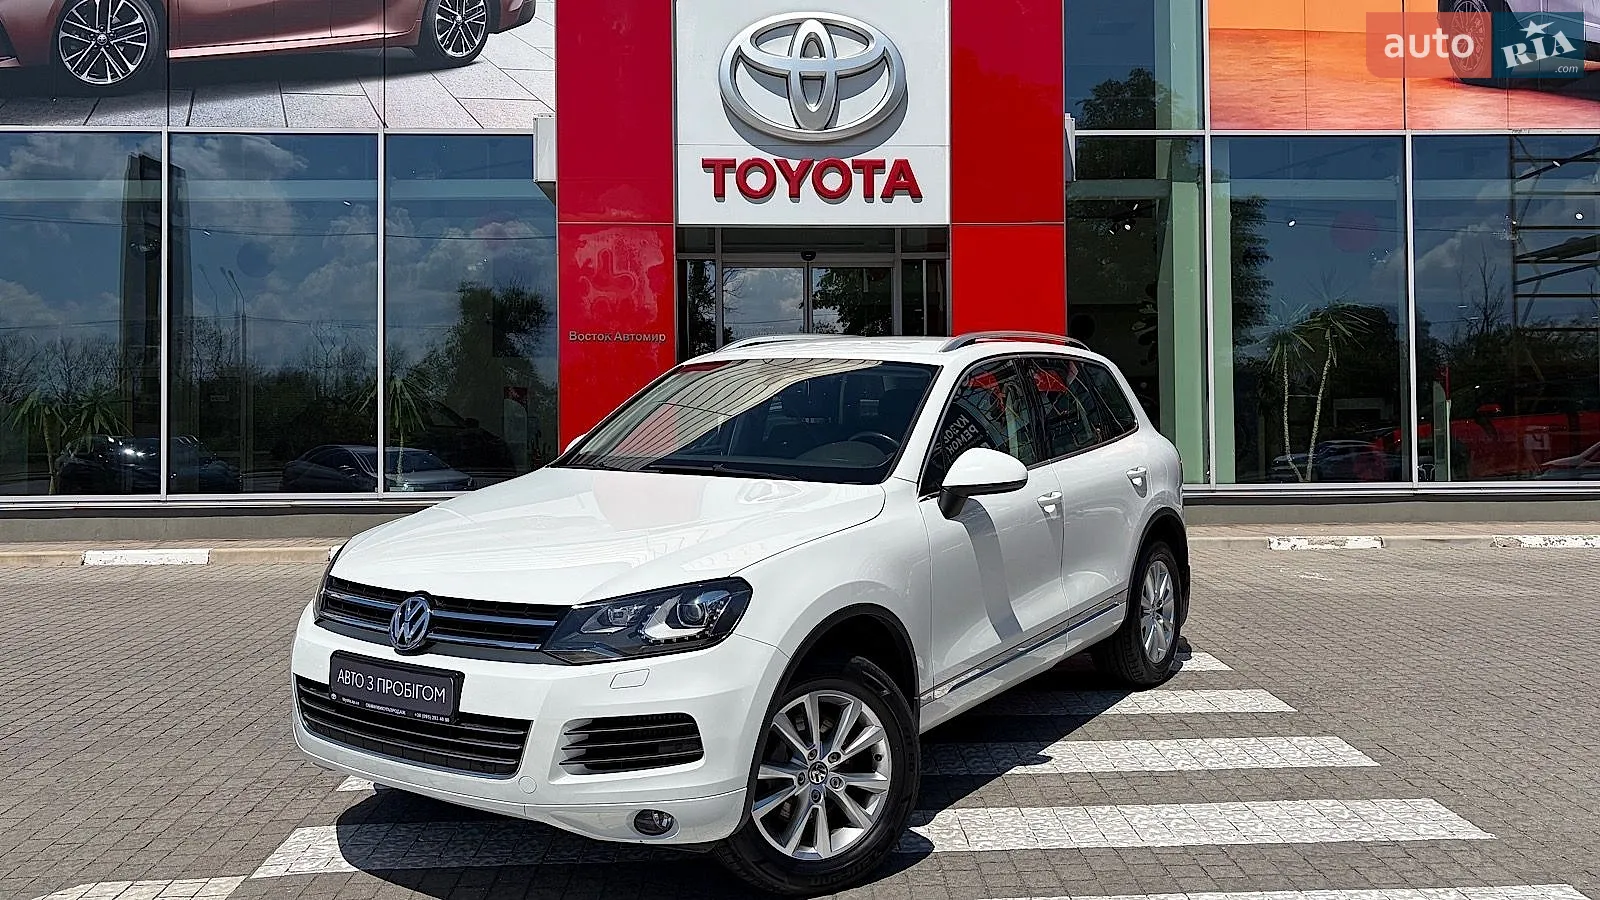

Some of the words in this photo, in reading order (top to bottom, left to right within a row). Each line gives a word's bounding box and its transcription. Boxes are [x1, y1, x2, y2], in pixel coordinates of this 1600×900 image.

[701, 157, 923, 202] TOYOTA
[569, 330, 612, 342] Восток
[337, 668, 364, 688] АВТО
[376, 677, 446, 704] ПРОБІГОМ
